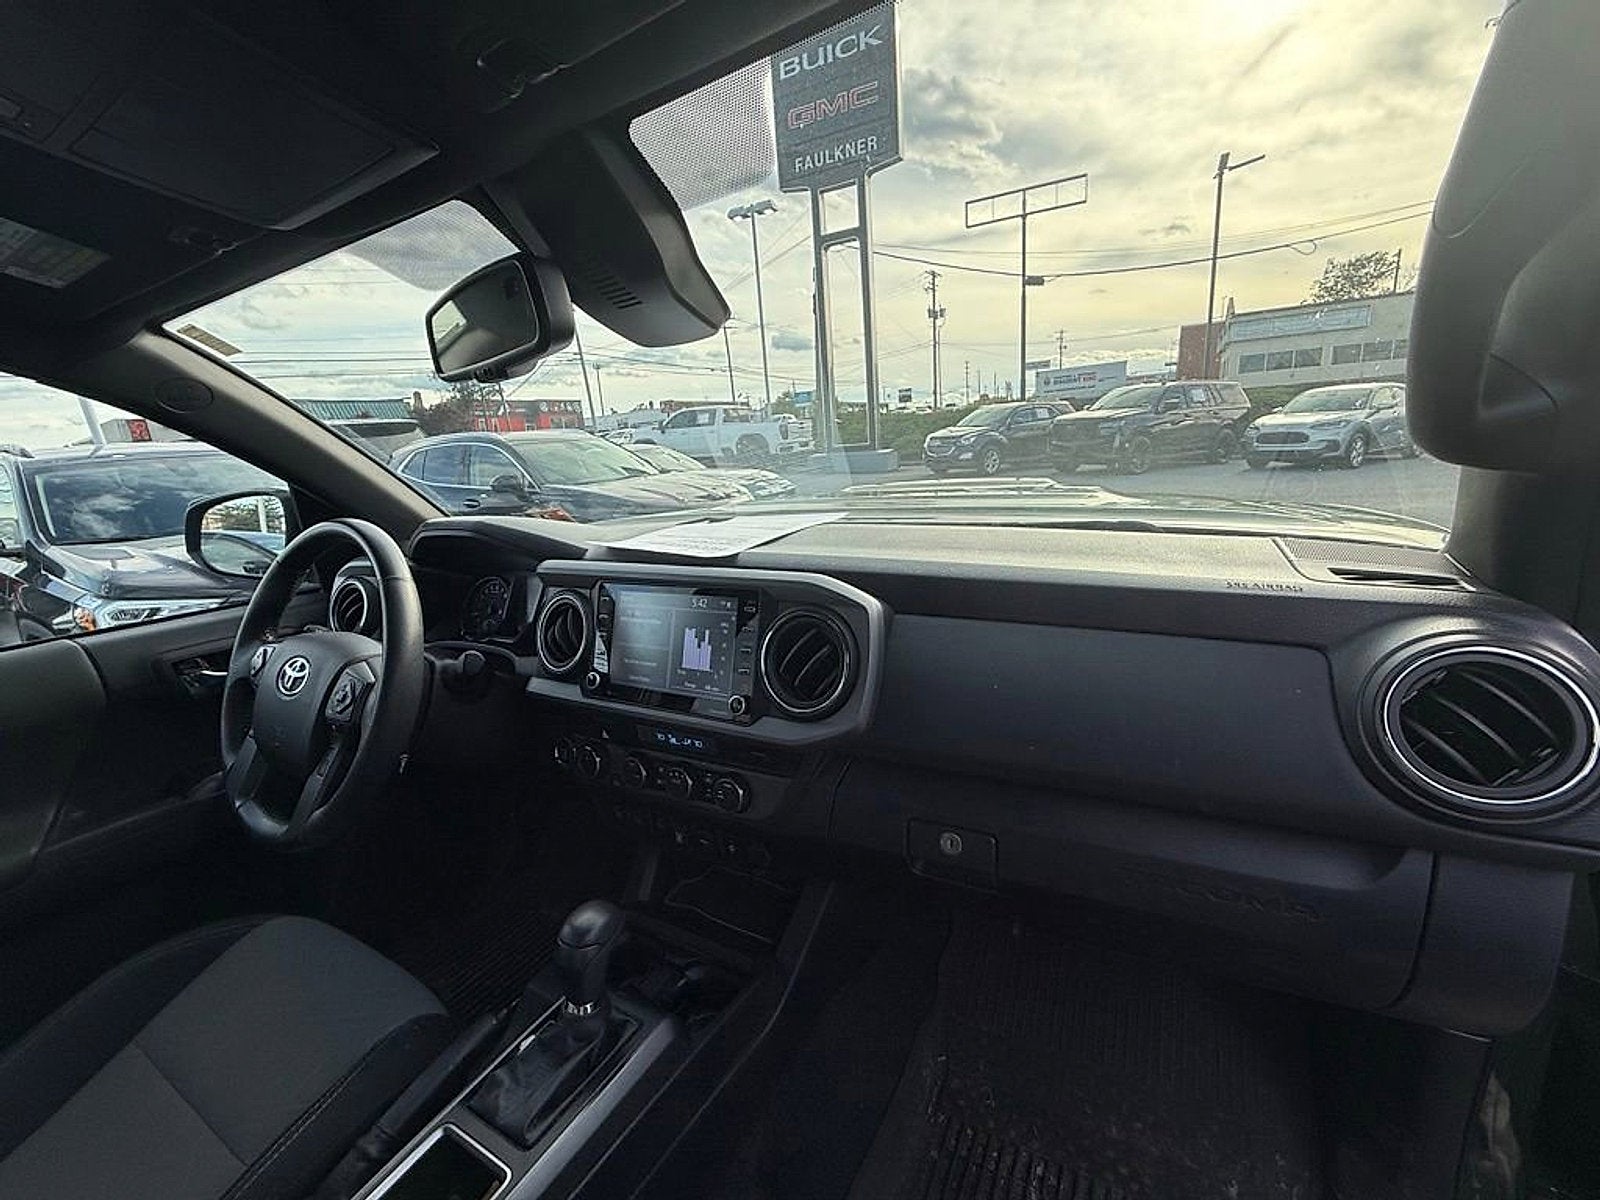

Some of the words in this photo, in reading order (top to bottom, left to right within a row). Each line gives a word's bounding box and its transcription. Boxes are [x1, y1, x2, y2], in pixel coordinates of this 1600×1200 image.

[779, 24, 883, 80] BUICK
[788, 81, 879, 129] GMC
[795, 135, 878, 173] FAULKNER
